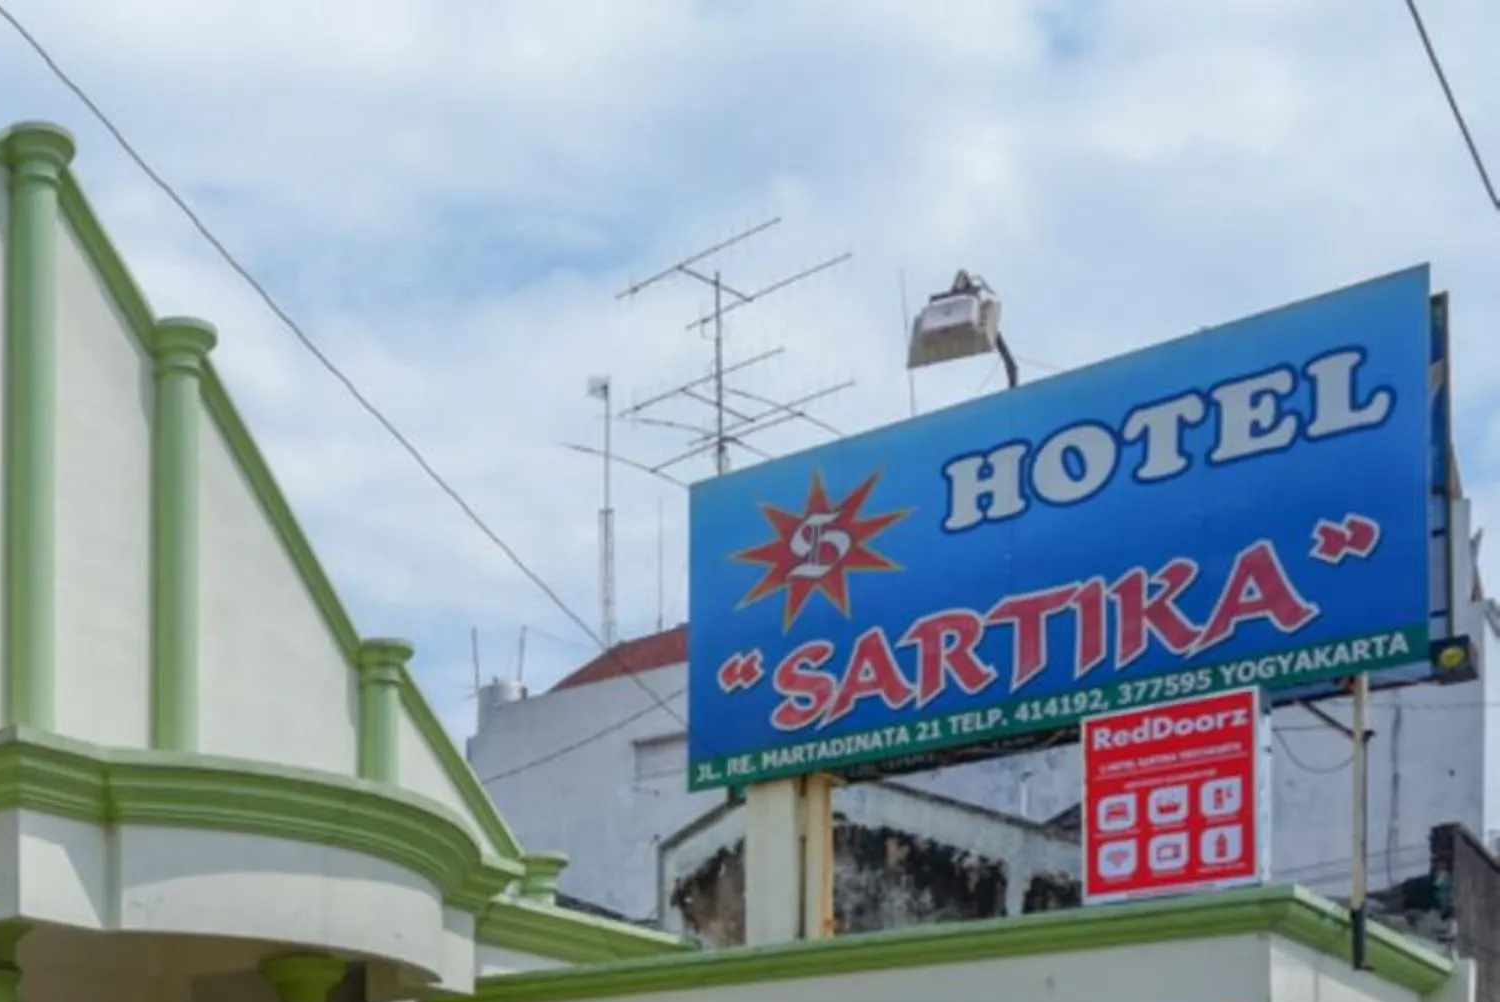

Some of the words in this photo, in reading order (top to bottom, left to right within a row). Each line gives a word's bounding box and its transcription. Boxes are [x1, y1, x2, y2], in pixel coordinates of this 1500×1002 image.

[941, 345, 1397, 533] HOTEL
[696, 762, 722, 784] JL.
[727, 756, 757, 777] RE.
[762, 727, 911, 770] MARTADINATA
[915, 721, 941, 741] 21
[949, 707, 1009, 736] TELP.
[1014, 689, 1109, 723] 414192,
[1118, 669, 1213, 704] 377595
[1220, 632, 1409, 687] YOGYAKARTA
[1092, 707, 1249, 750] RedDoorz
